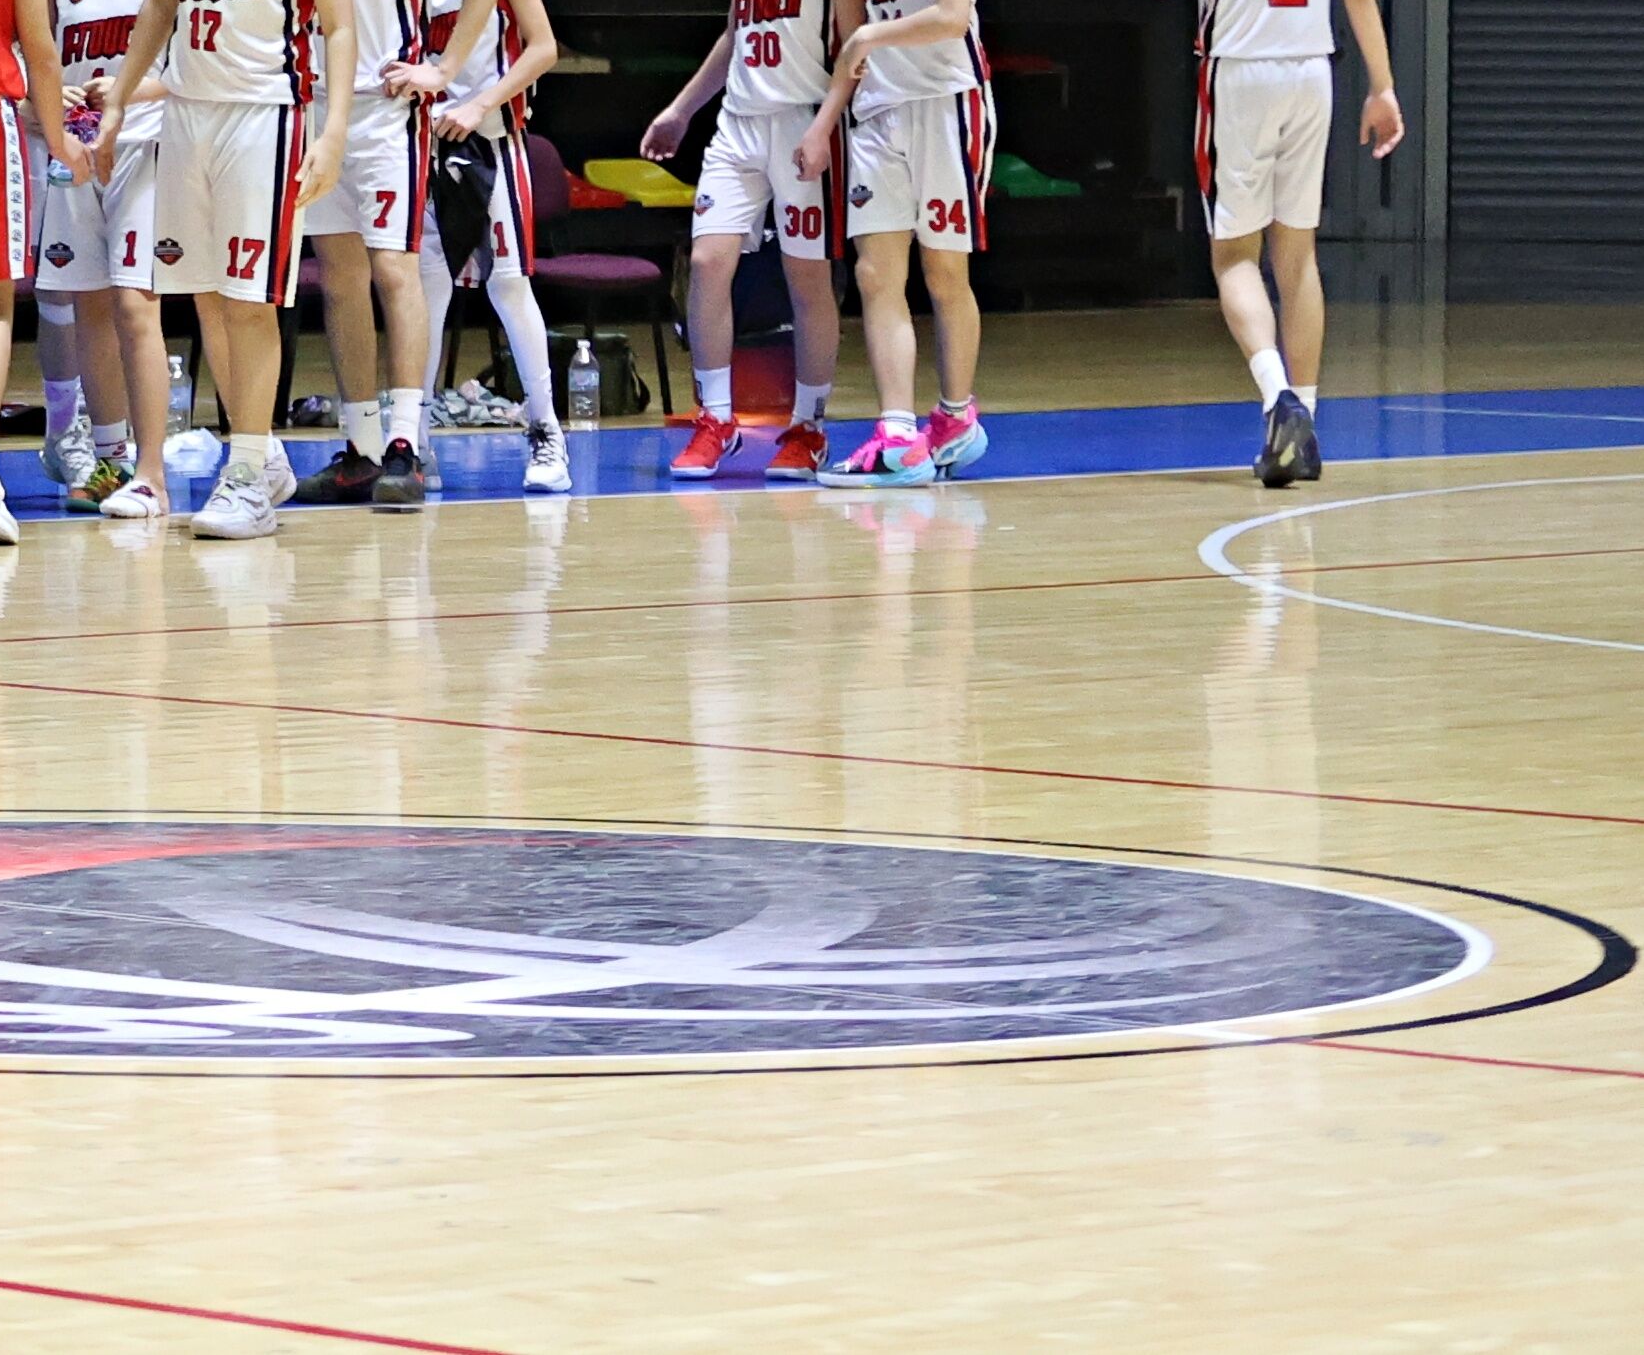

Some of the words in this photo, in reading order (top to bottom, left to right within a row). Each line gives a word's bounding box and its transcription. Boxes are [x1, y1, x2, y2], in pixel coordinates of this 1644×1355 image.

[189, 7, 223, 53] 17
[744, 31, 782, 68] 30
[372, 189, 397, 229] 7
[783, 204, 823, 241] 30
[926, 198, 968, 235] 34
[121, 229, 138, 268] 1
[226, 235, 266, 281] 17
